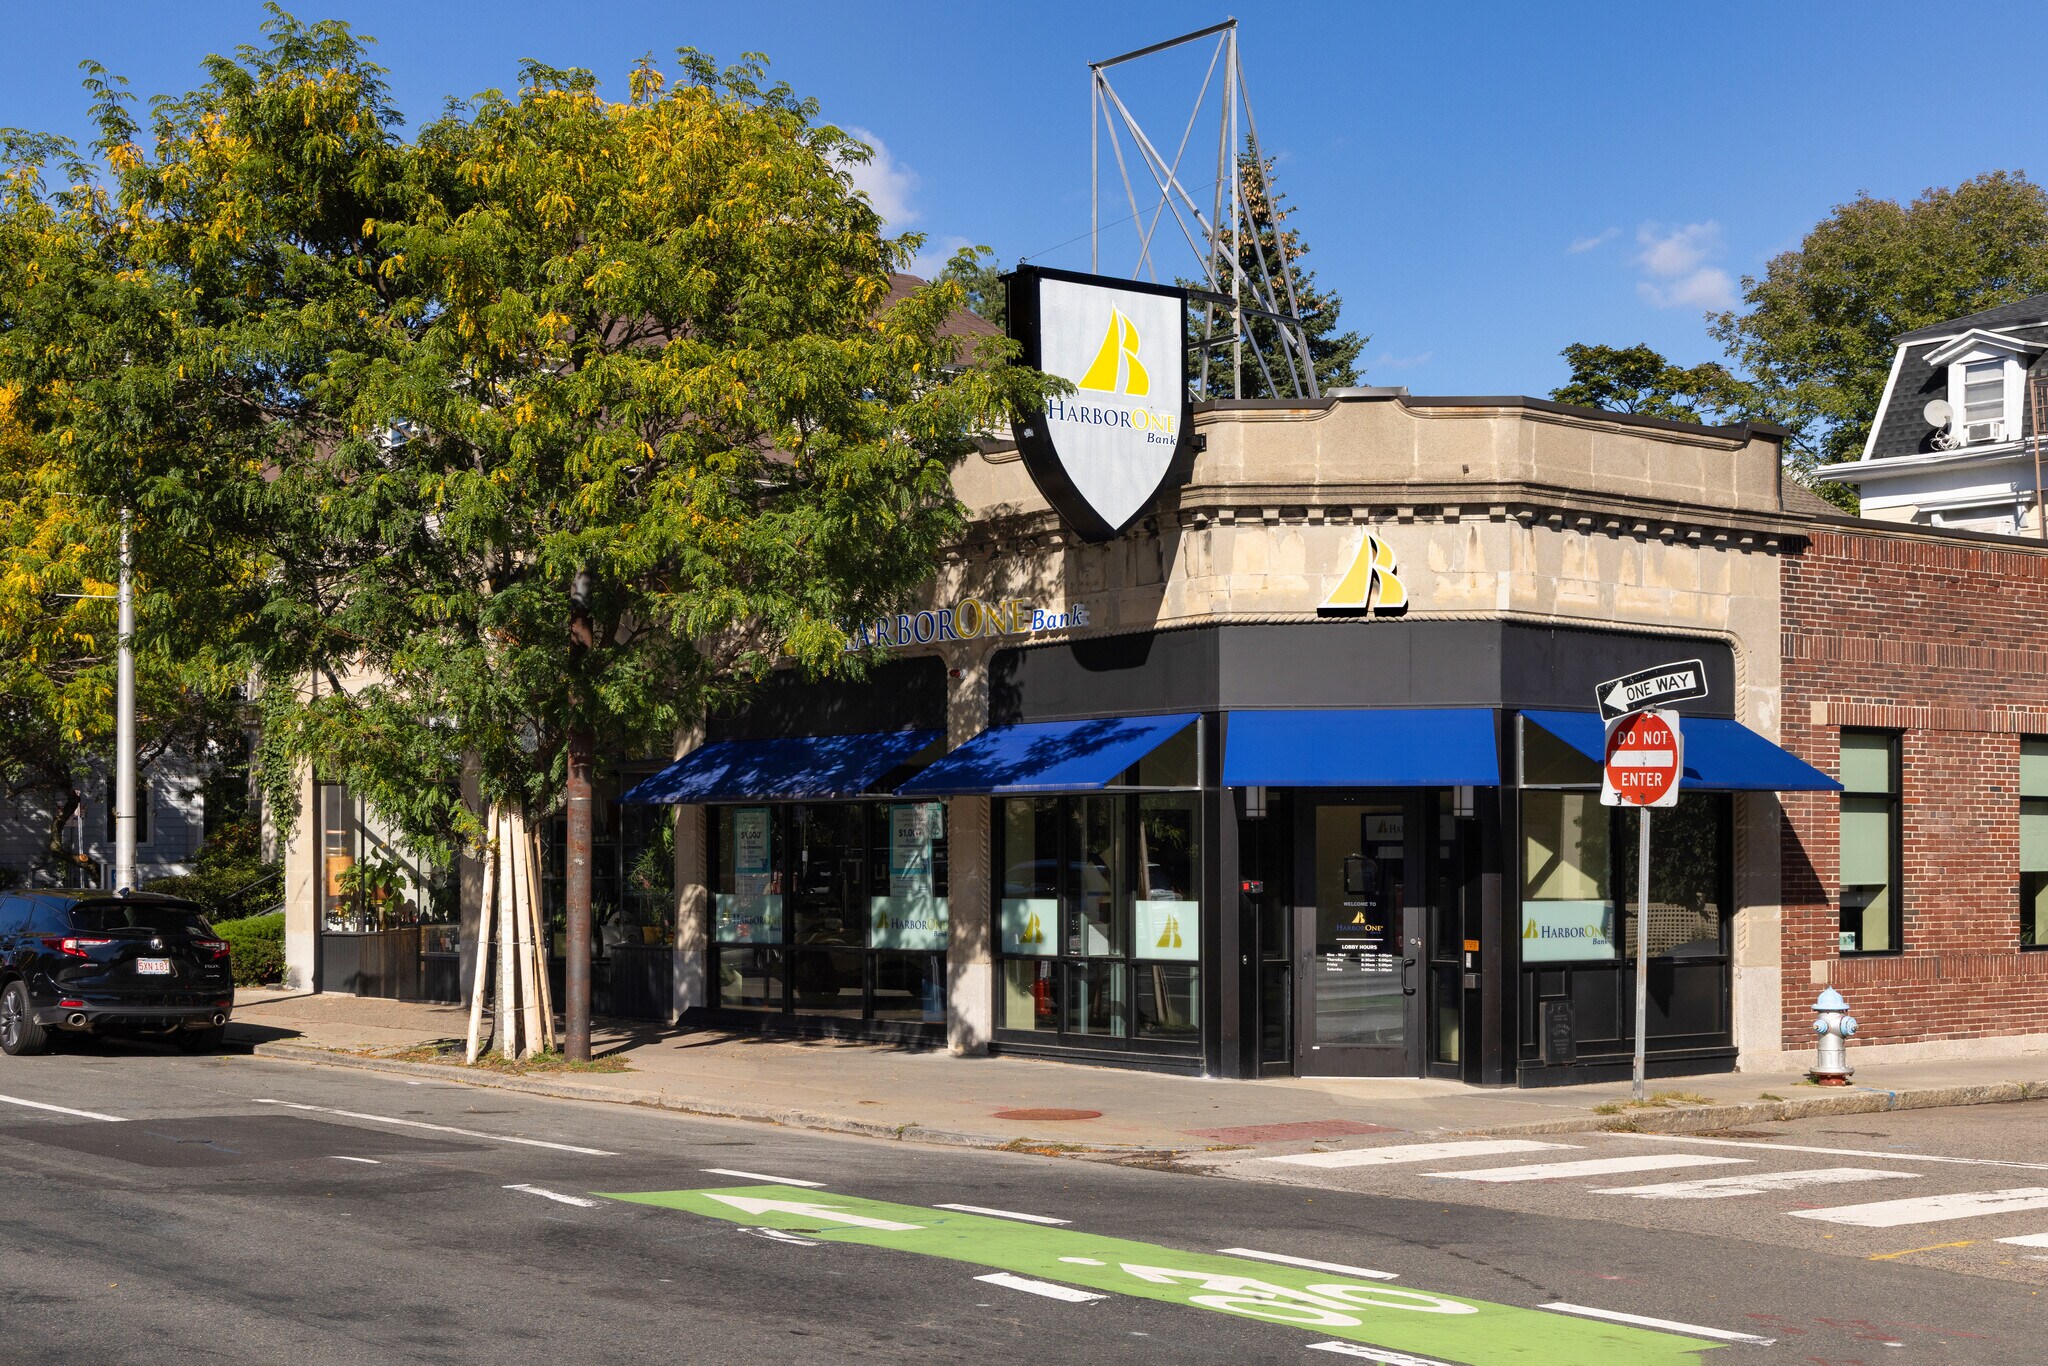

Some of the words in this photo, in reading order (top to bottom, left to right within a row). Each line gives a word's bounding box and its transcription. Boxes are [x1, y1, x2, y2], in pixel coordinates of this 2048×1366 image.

[1146, 432, 1176, 446] Bank
[1032, 604, 1084, 632] Bank
[1626, 679, 1654, 701] ONE
[1655, 671, 1689, 693] WAY
[1617, 730, 1636, 745] DO
[1643, 729, 1669, 745] NOT
[1621, 772, 1663, 787] ENTER
[933, 930, 949, 938] Bank
[137, 961, 153, 971] 5XN
[154, 961, 169, 971] 181
